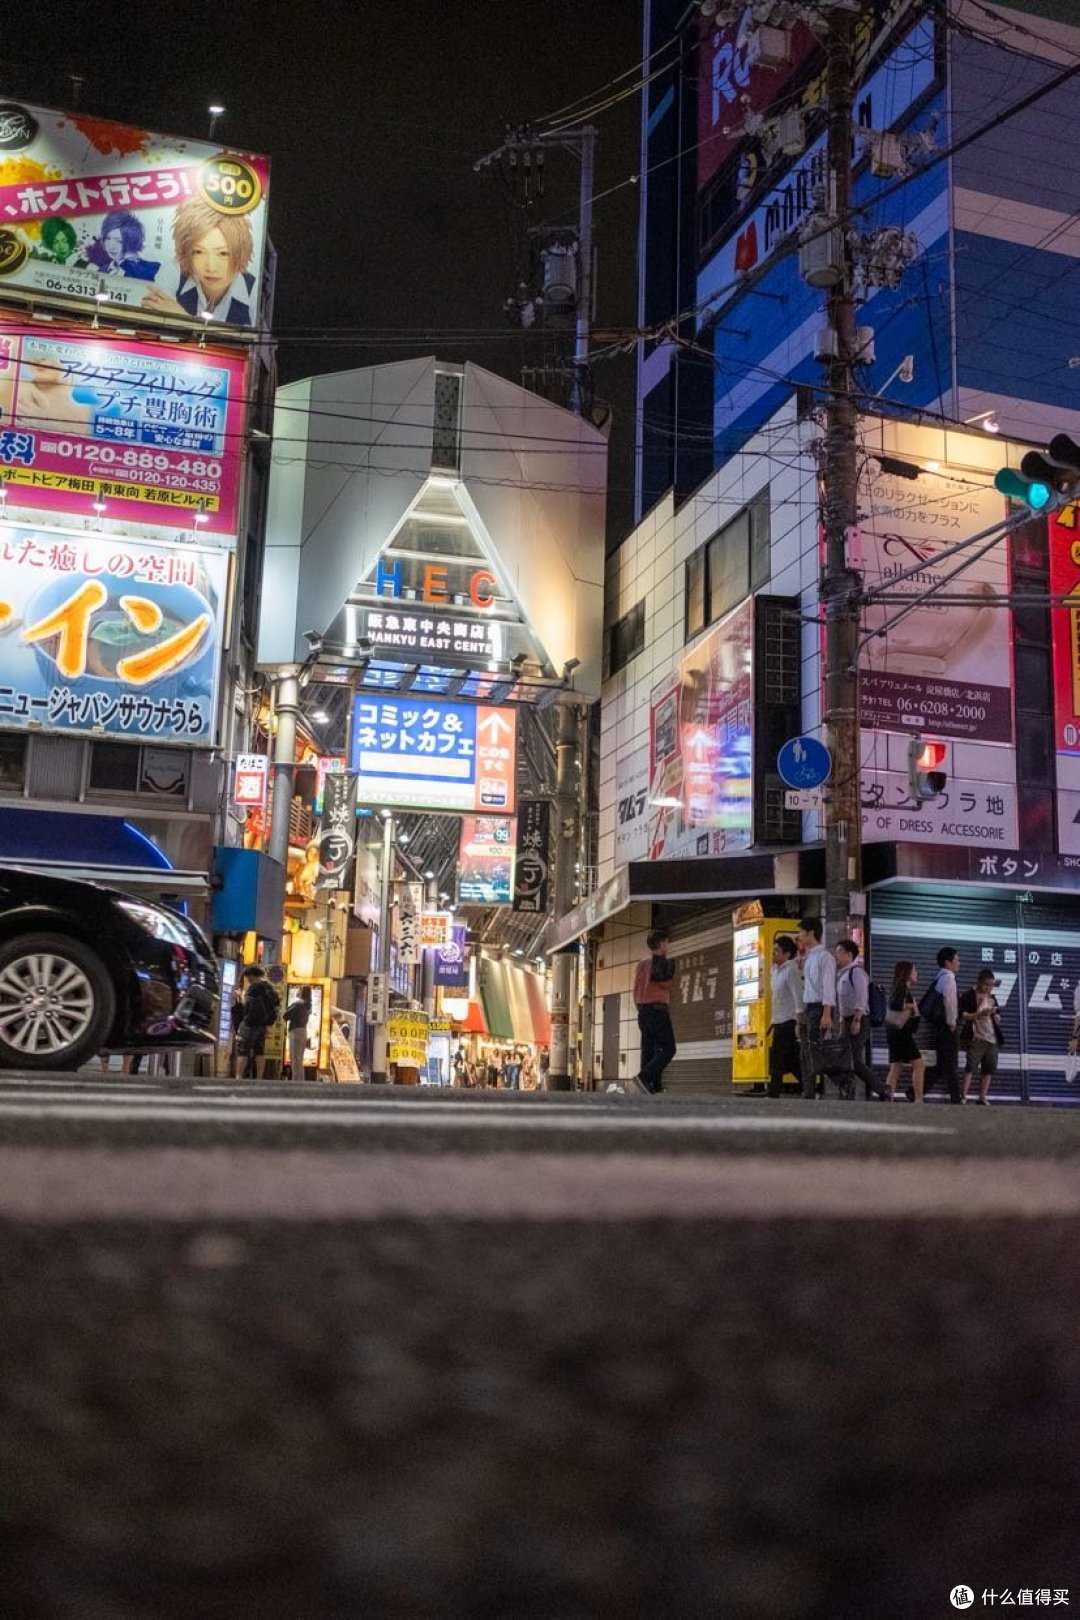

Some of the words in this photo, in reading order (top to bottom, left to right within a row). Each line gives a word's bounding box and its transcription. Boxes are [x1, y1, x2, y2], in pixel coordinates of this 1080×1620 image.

[206, 173, 253, 199] 500
[58, 359, 222, 401] アクアフィリング
[58, 440, 222, 479] 0120-889-480
[367, 630, 416, 646] HANKYU
[419, 637, 451, 650] EAST
[453, 640, 498, 655] CENTE
[0, 687, 203, 734] ニュージャパンサウナうら
[358, 703, 463, 733] コミック&
[357, 729, 475, 756] ネットカフェ
[876, 816, 892, 831] OF
[899, 818, 934, 833] DRESS
[941, 823, 1005, 840] ACCESSORIE
[980, 855, 1039, 878] ボタン
[981, 946, 1064, 967] 服飾の店
[681, 967, 719, 1005] タムラ
